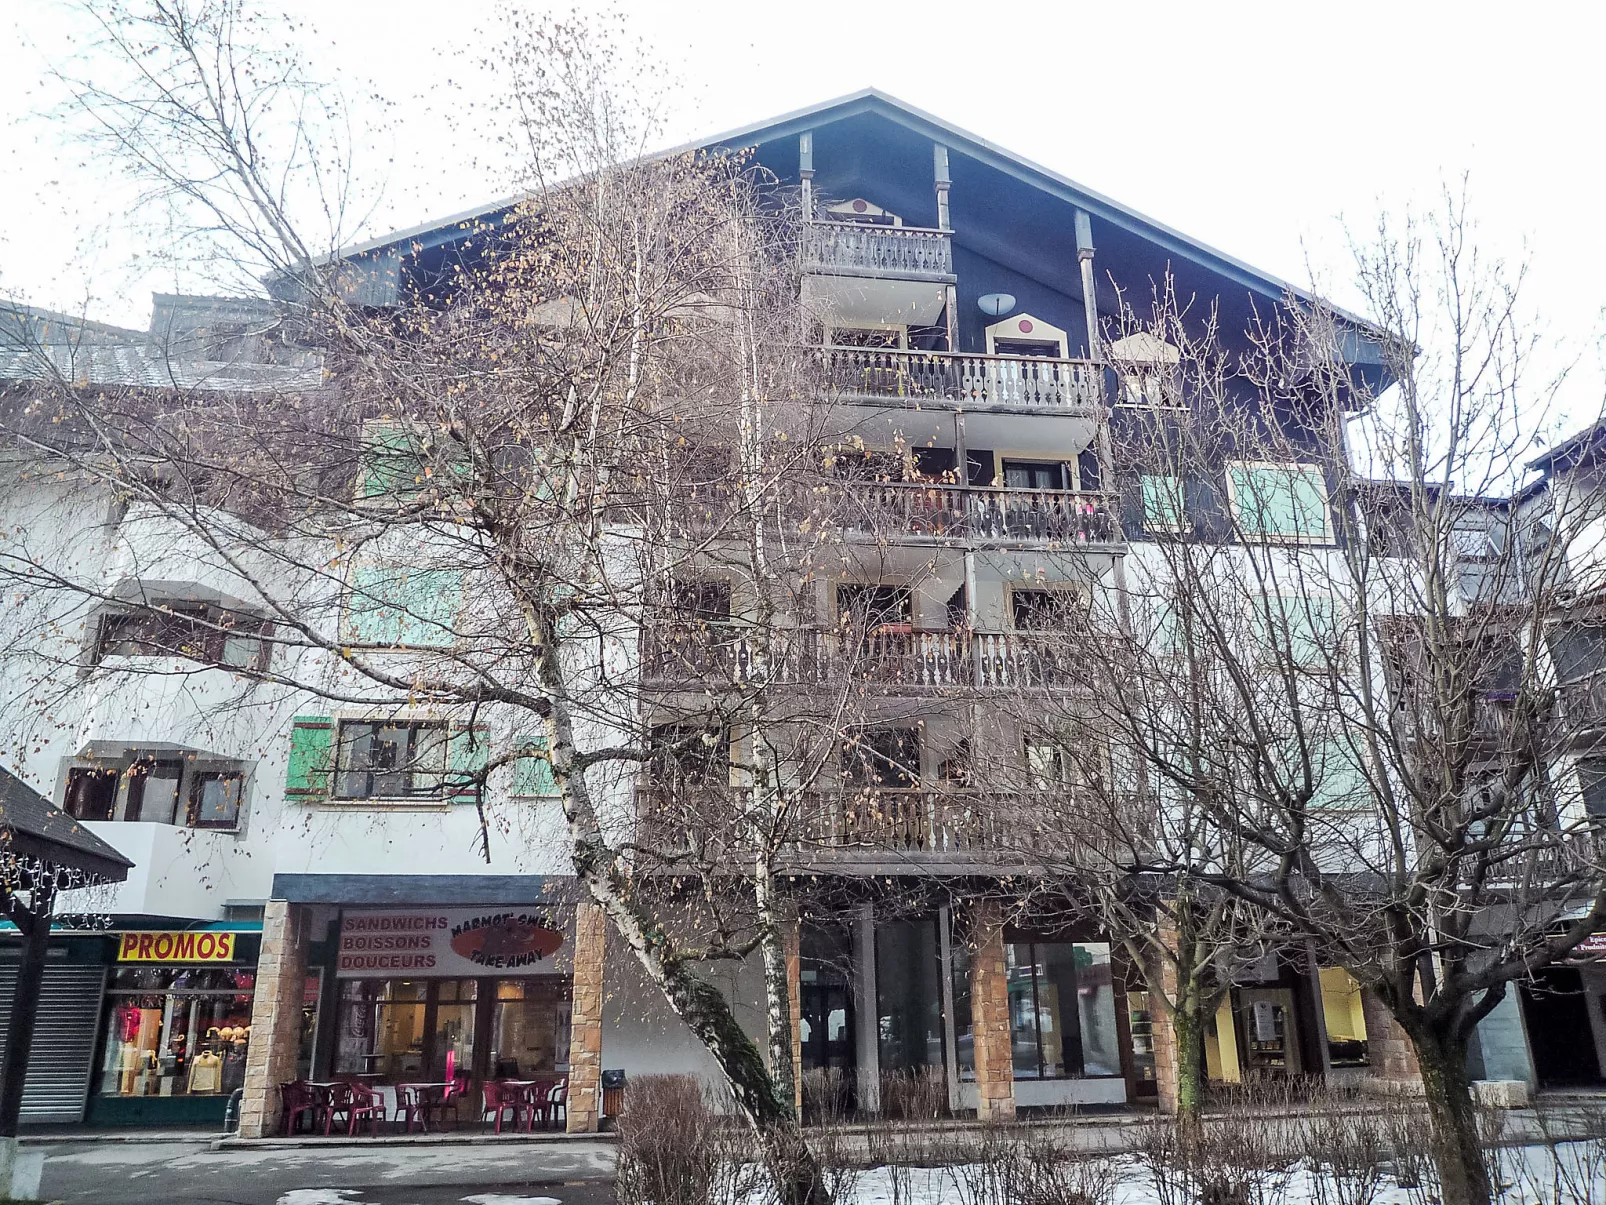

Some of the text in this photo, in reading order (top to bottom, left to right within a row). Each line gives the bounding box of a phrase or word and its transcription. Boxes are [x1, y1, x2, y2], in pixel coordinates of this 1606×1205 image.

[344, 916, 448, 931] SANDWICHS
[122, 933, 230, 959] PROMOS
[343, 935, 431, 950] BOISSONS
[341, 954, 437, 969] DOUCEURS
